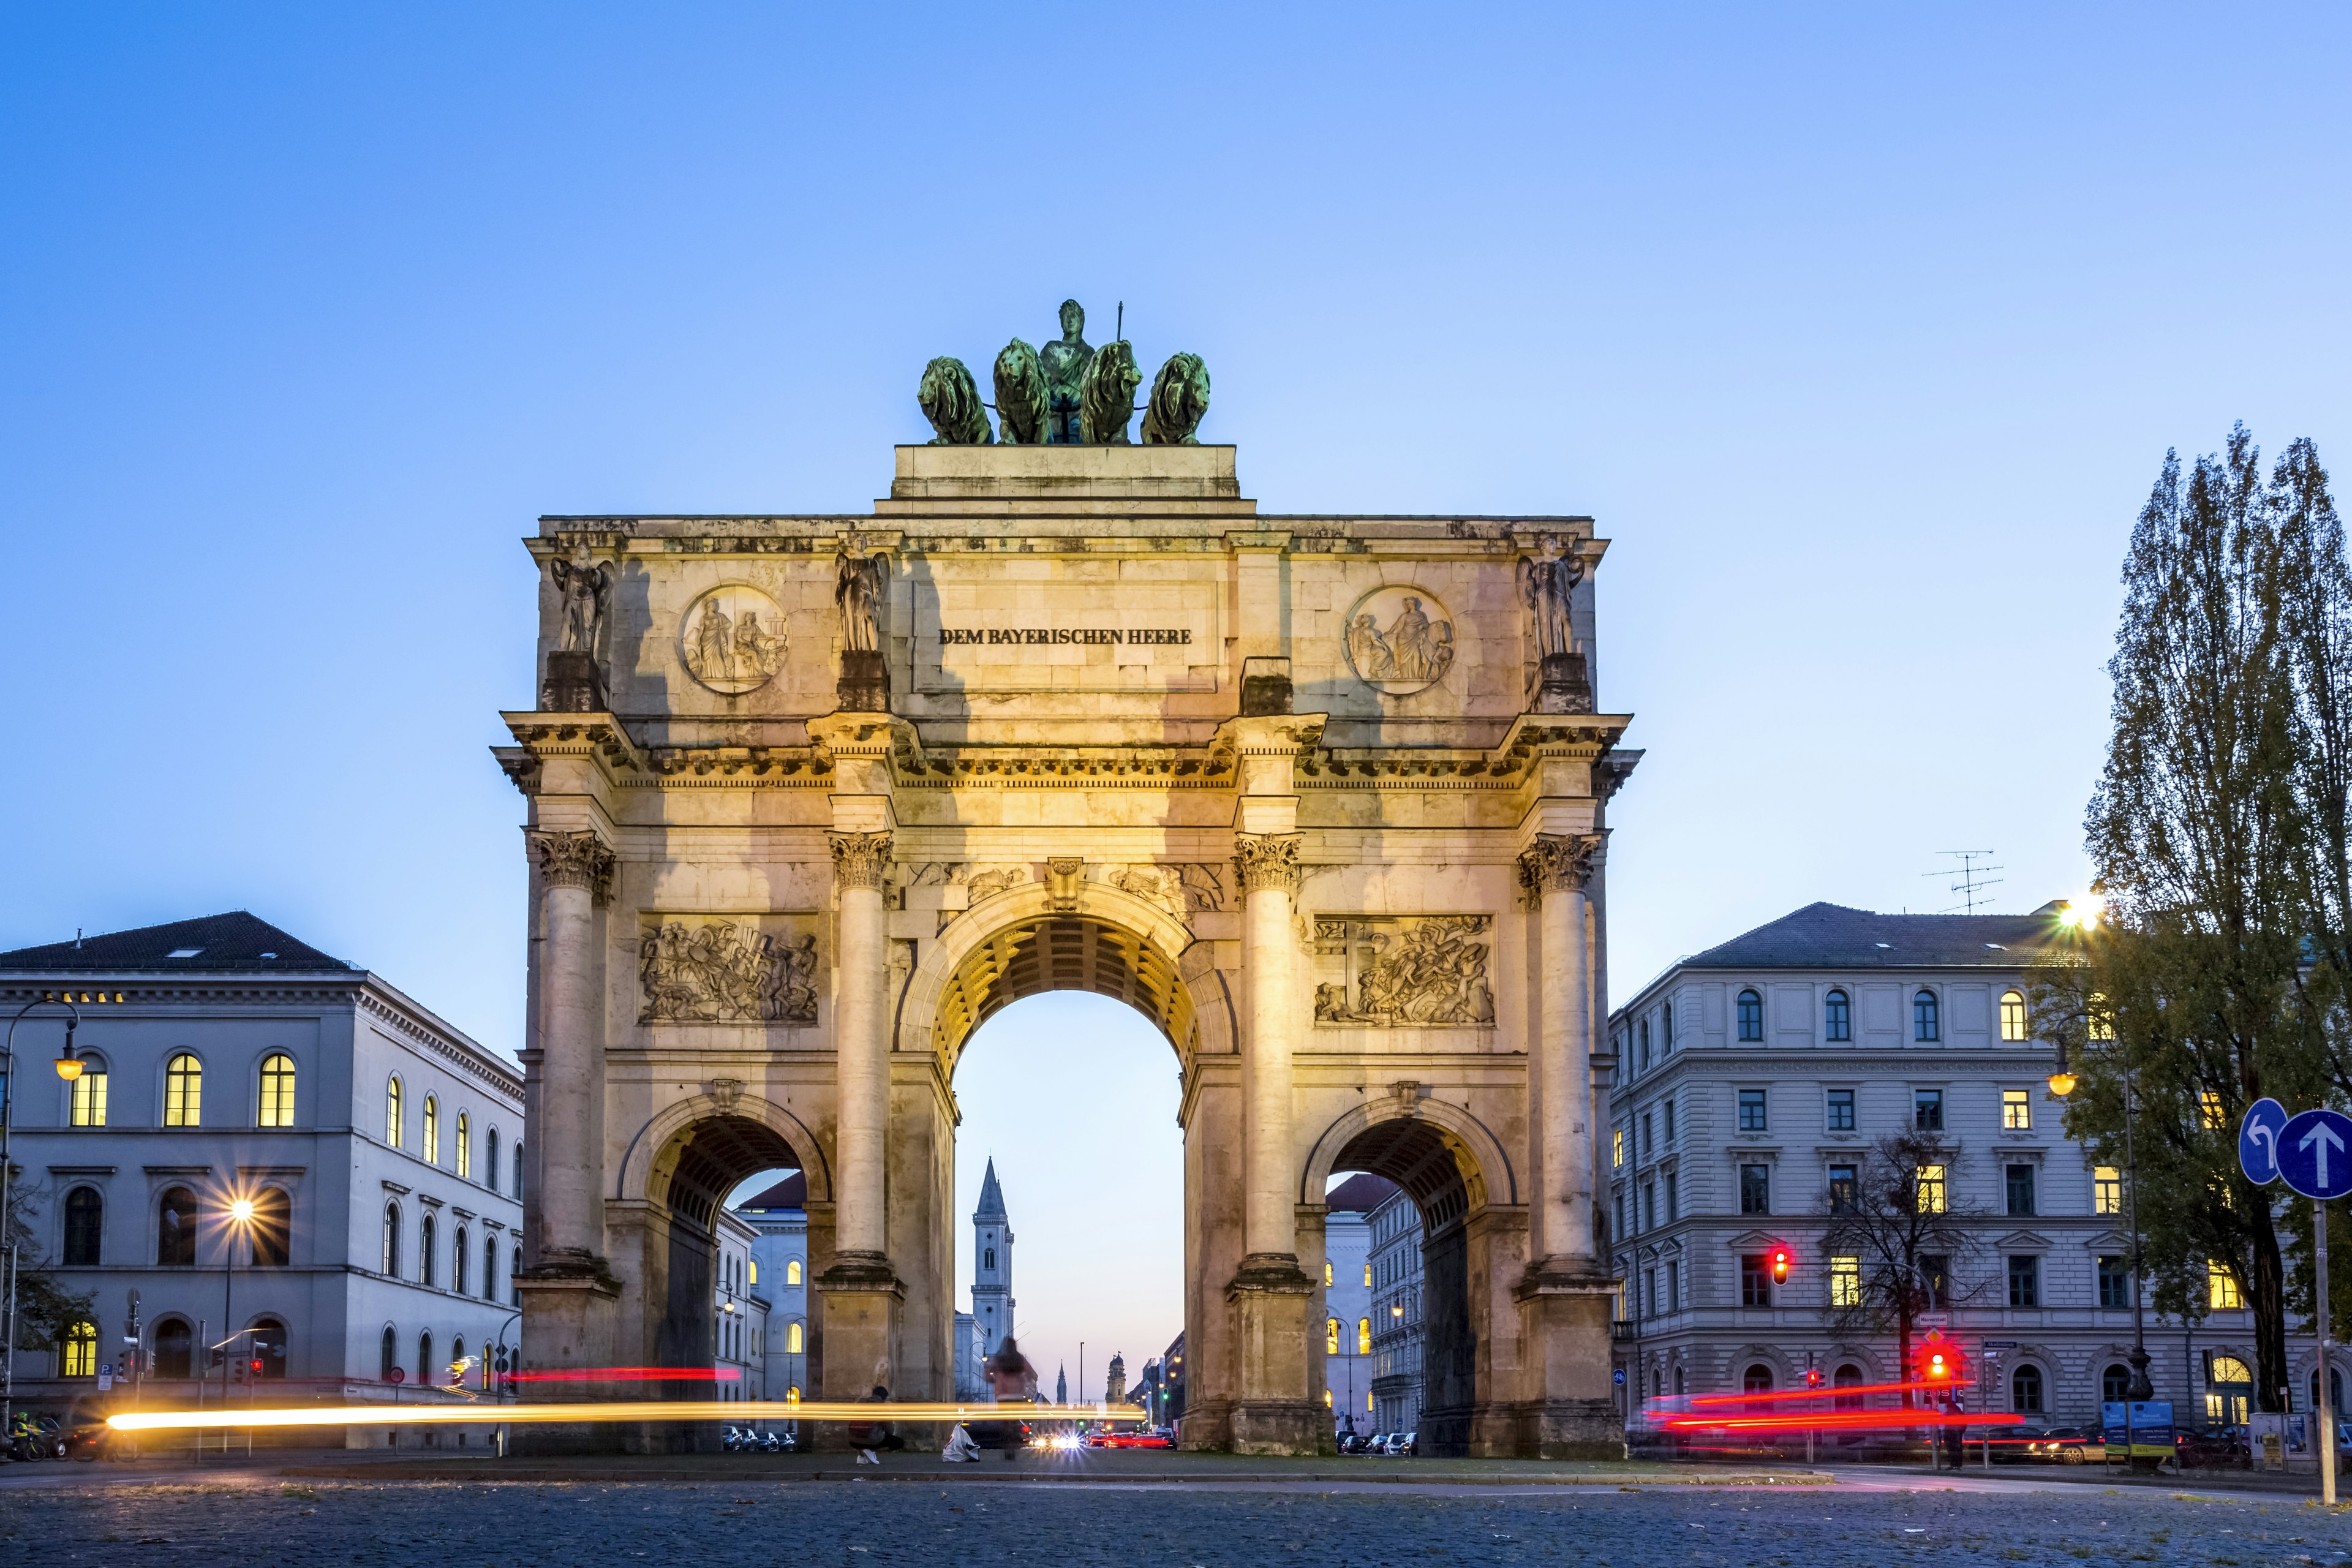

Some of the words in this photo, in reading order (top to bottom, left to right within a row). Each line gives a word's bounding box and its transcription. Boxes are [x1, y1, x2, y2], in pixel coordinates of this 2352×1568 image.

[939, 629, 984, 644] DEM
[987, 629, 1123, 644] BAYERISCHEN
[1127, 629, 1192, 644] HEERE
[101, 1365, 110, 1374] P
